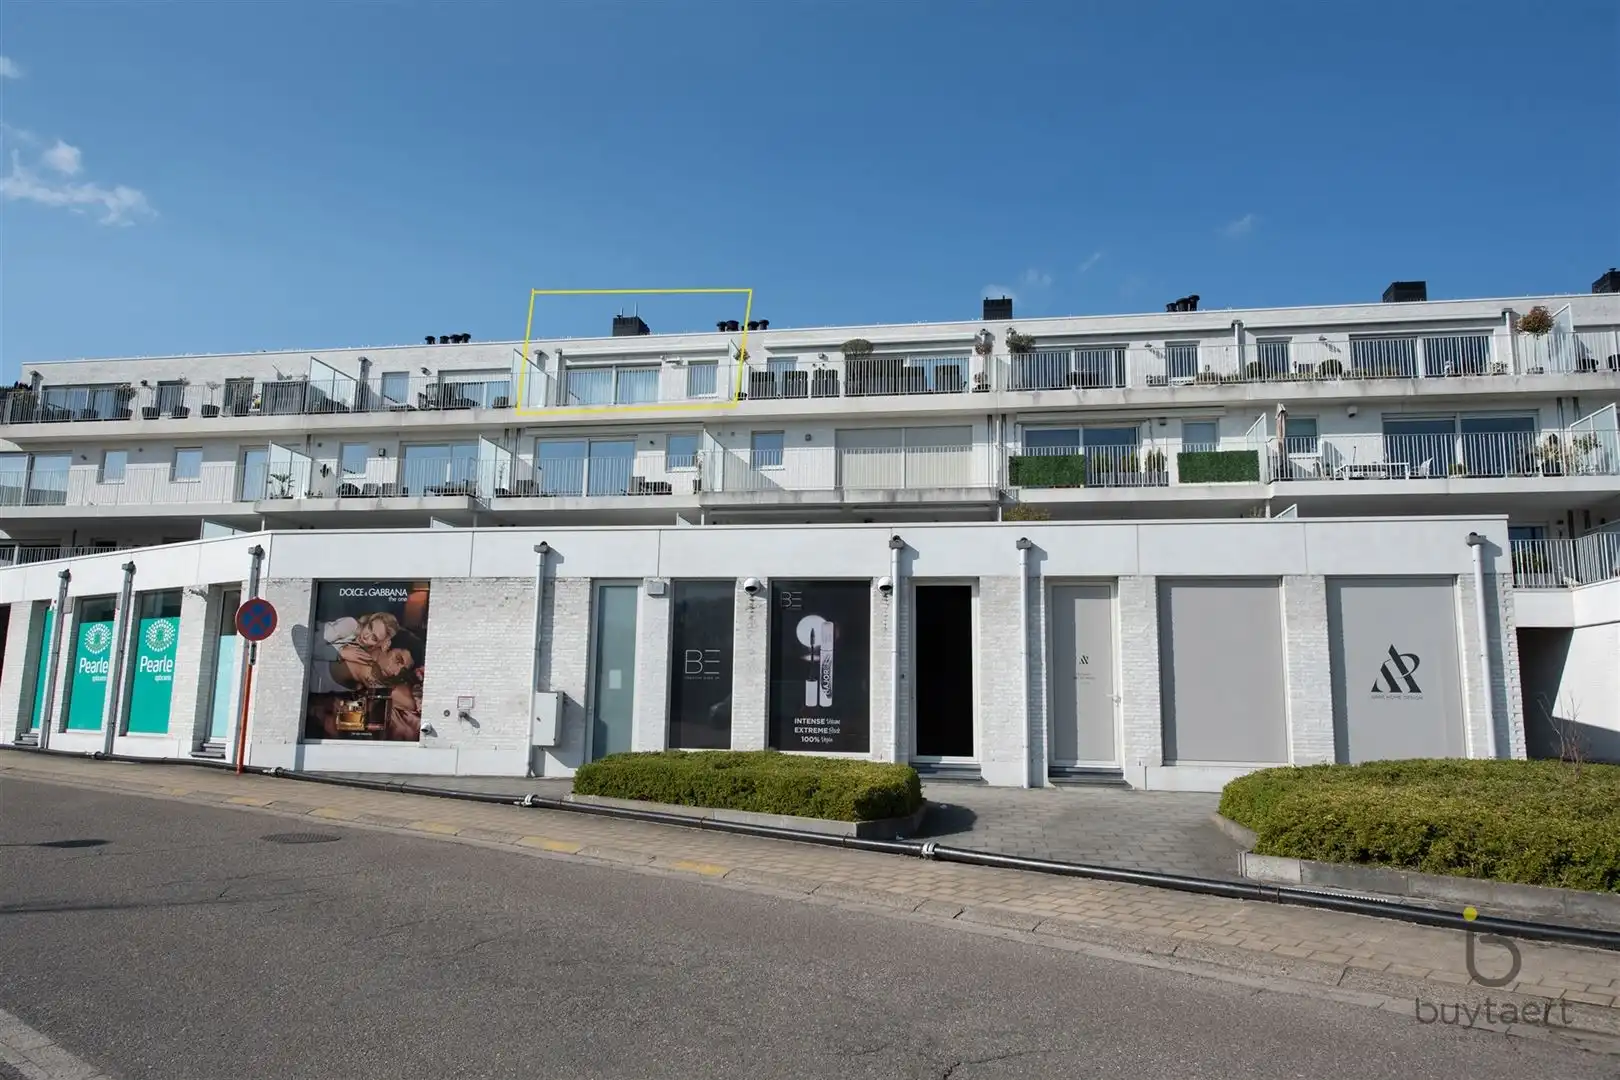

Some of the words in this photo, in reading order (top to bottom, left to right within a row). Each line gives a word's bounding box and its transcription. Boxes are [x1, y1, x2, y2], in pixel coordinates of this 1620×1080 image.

[339, 588, 364, 596] DOLCE
[368, 588, 408, 596] GABBANA
[79, 657, 109, 673] Pearle
[140, 654, 173, 672] Pearle
[685, 649, 720, 674] BE
